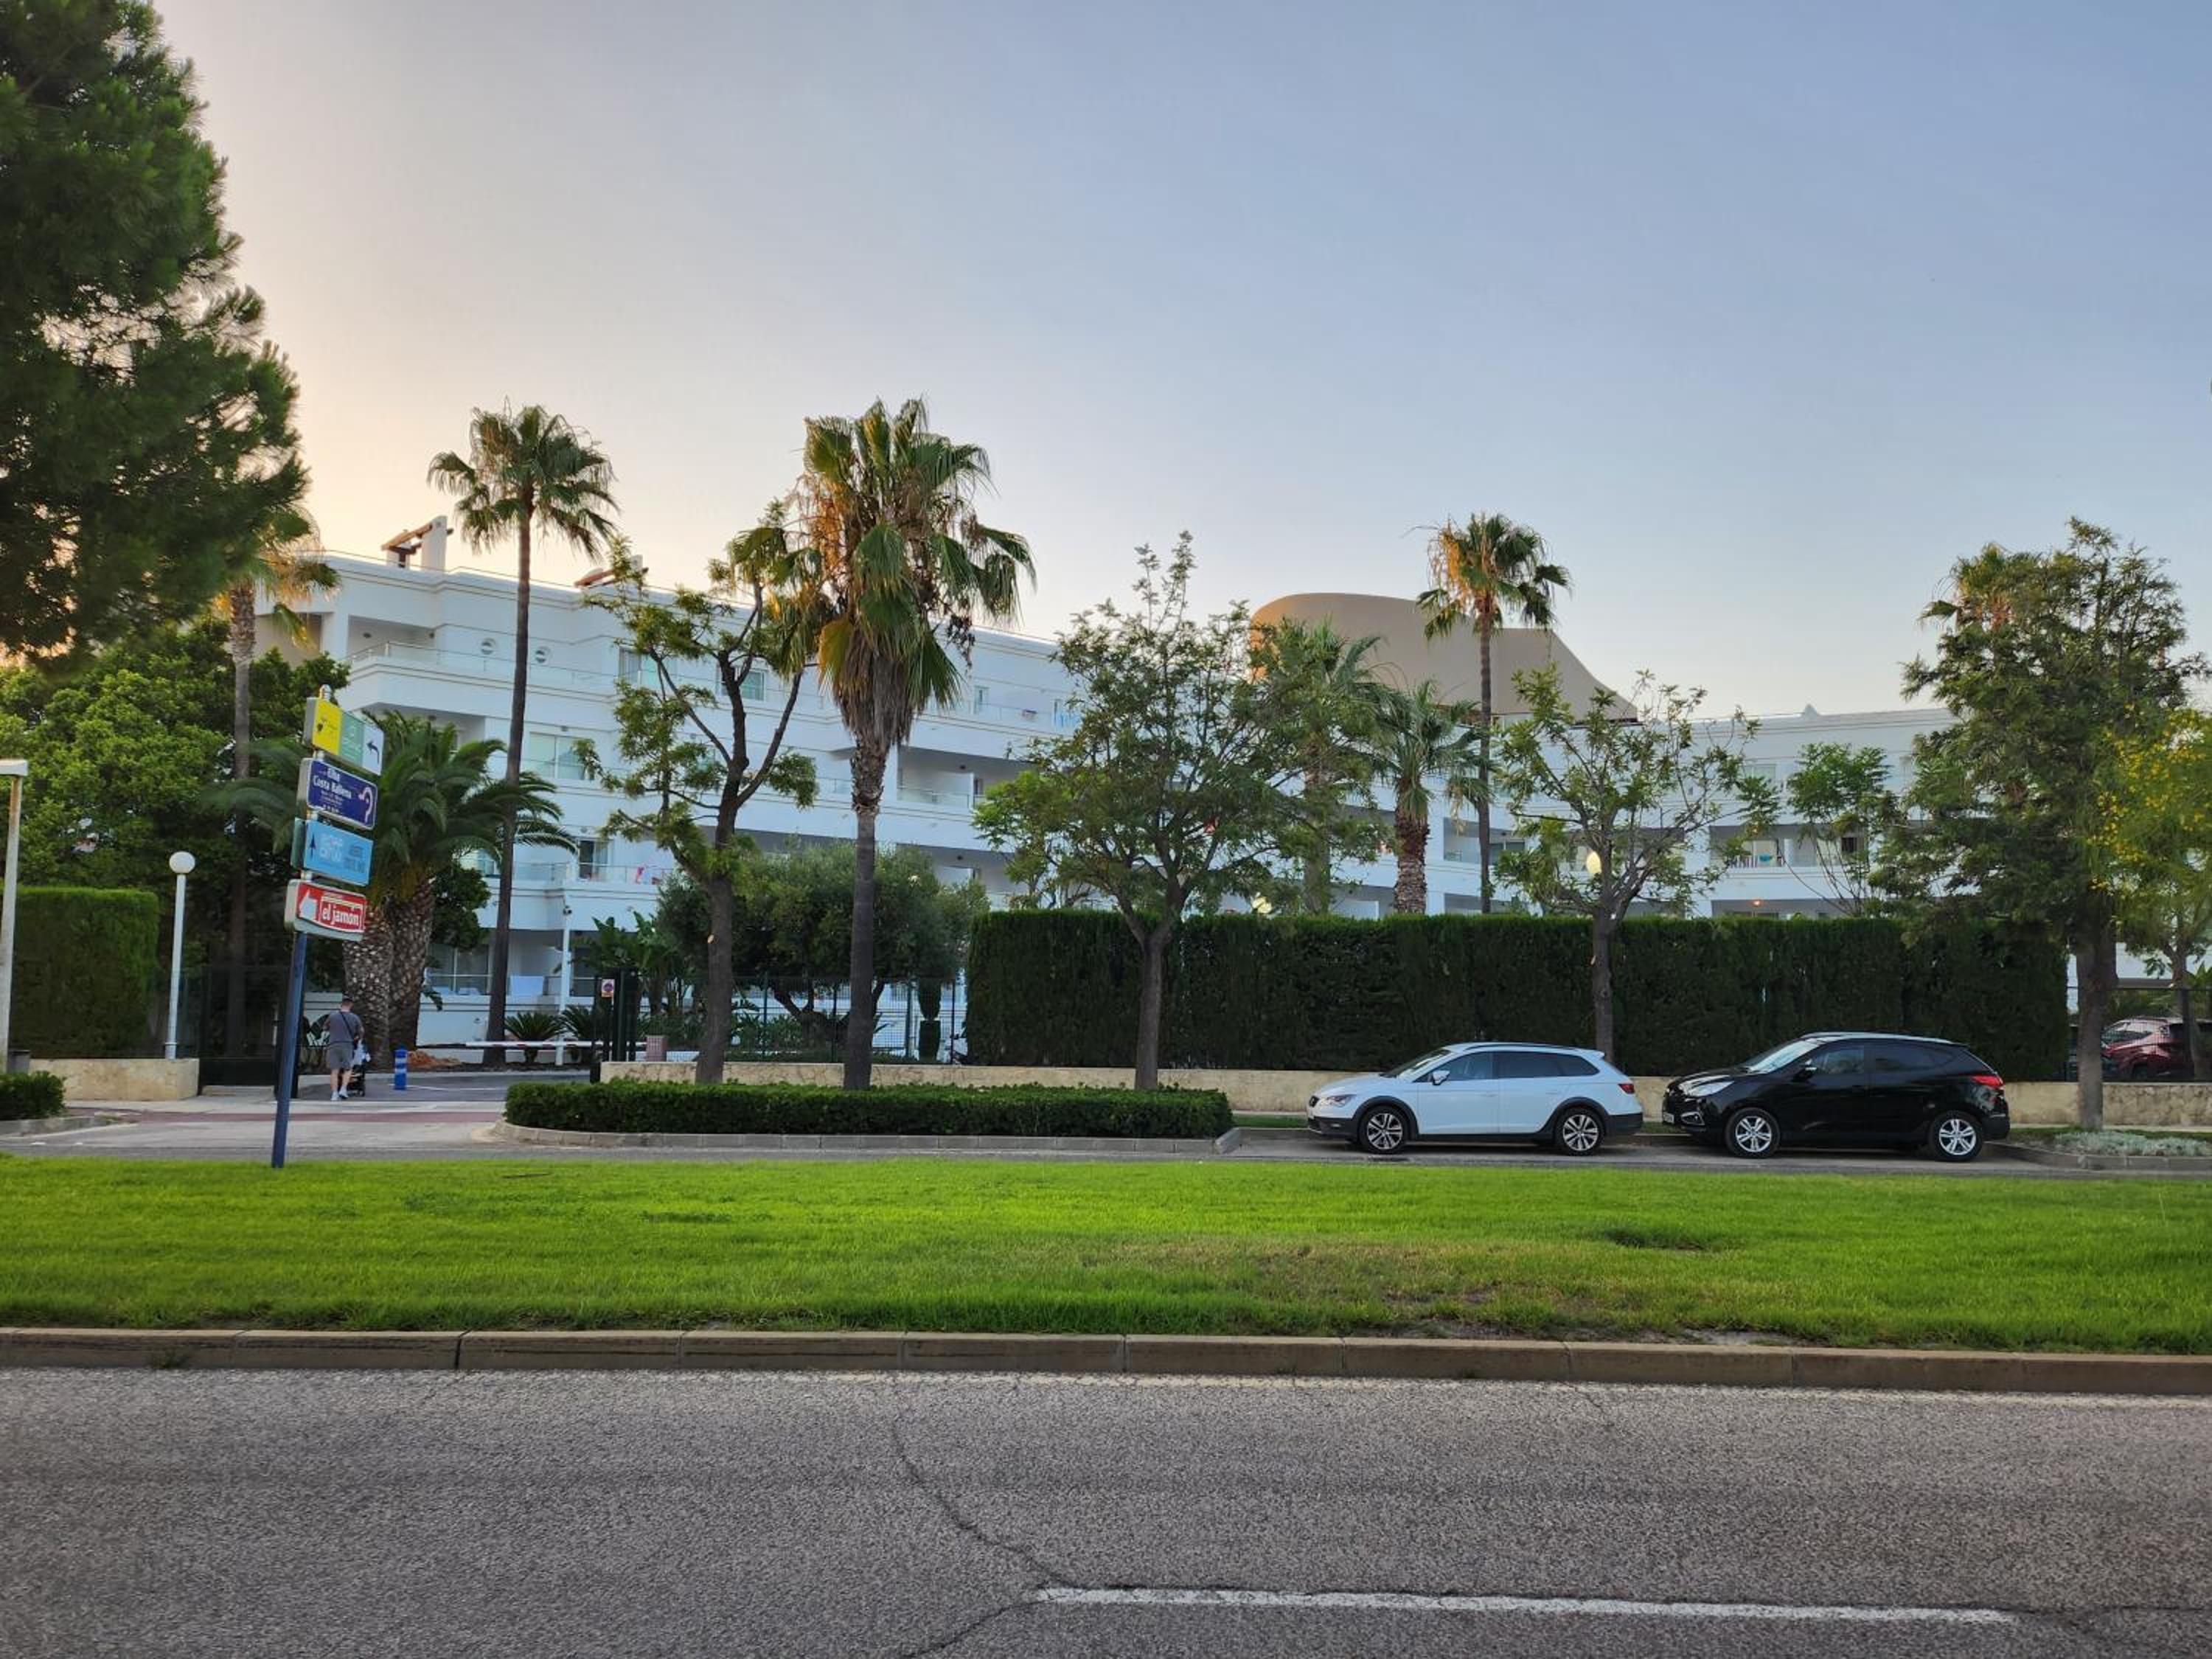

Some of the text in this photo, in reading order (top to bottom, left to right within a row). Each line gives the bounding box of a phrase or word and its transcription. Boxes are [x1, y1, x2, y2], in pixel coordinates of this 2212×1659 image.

[313, 776, 330, 790] Costa
[322, 903, 359, 925] el jamón
